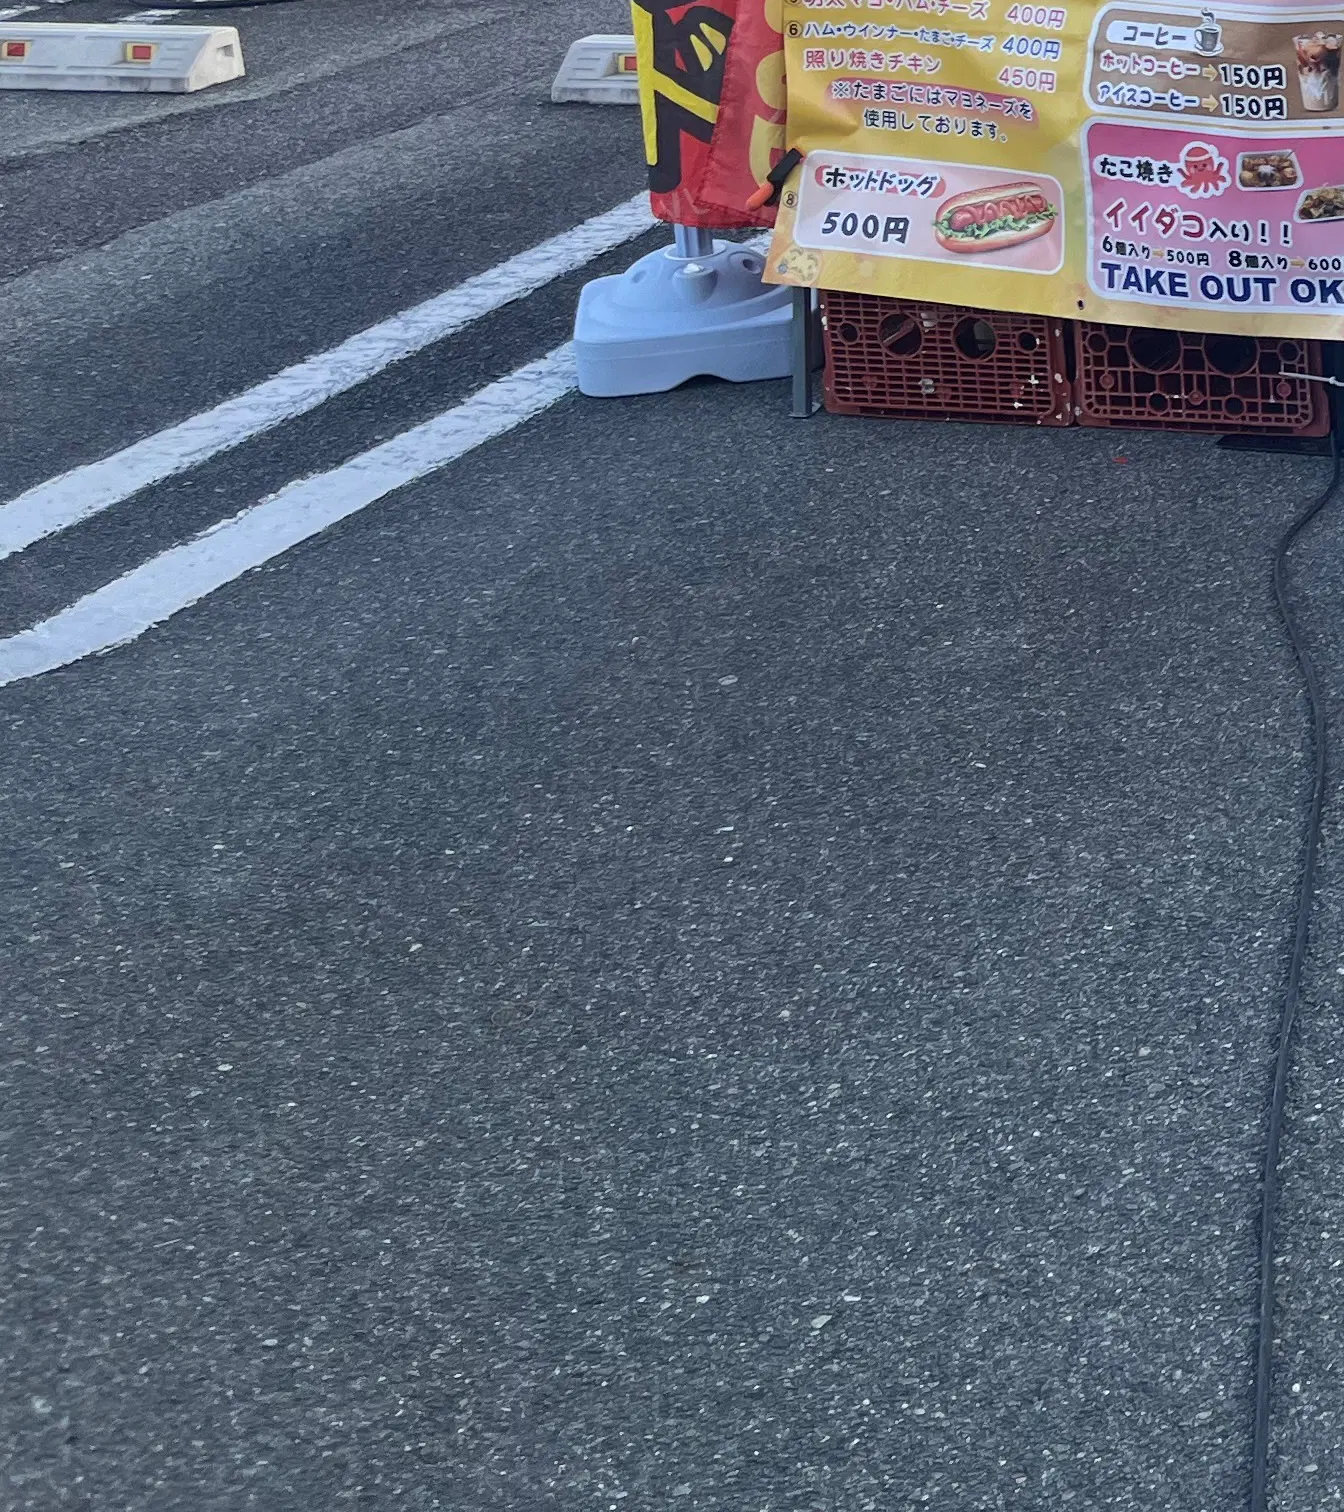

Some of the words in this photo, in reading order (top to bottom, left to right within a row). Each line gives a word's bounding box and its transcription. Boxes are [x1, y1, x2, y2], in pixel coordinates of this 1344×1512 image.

[1006, 5, 1065, 28] 400円
[1003, 38, 1061, 60] 400円
[1123, 25, 1187, 46] コーヒー
[804, 50, 941, 74] 照り焼きチキン
[998, 68, 1056, 91] 450円
[1102, 52, 1198, 77] ホットコーヒー
[1220, 65, 1284, 87] 150円
[1098, 84, 1198, 107] アイスコーヒー
[1221, 96, 1285, 118] 150円
[863, 109, 1008, 142] 使用しております。
[824, 167, 937, 196] ホットドッグ
[1099, 157, 1173, 183] たこ焼き
[821, 211, 910, 244] 500円
[1101, 235, 1151, 259] 6個入り
[1166, 249, 1210, 267] 500円
[1228, 250, 1288, 270] 8個入り
[1100, 262, 1190, 298] TAKE
[1200, 273, 1278, 303] OUT
